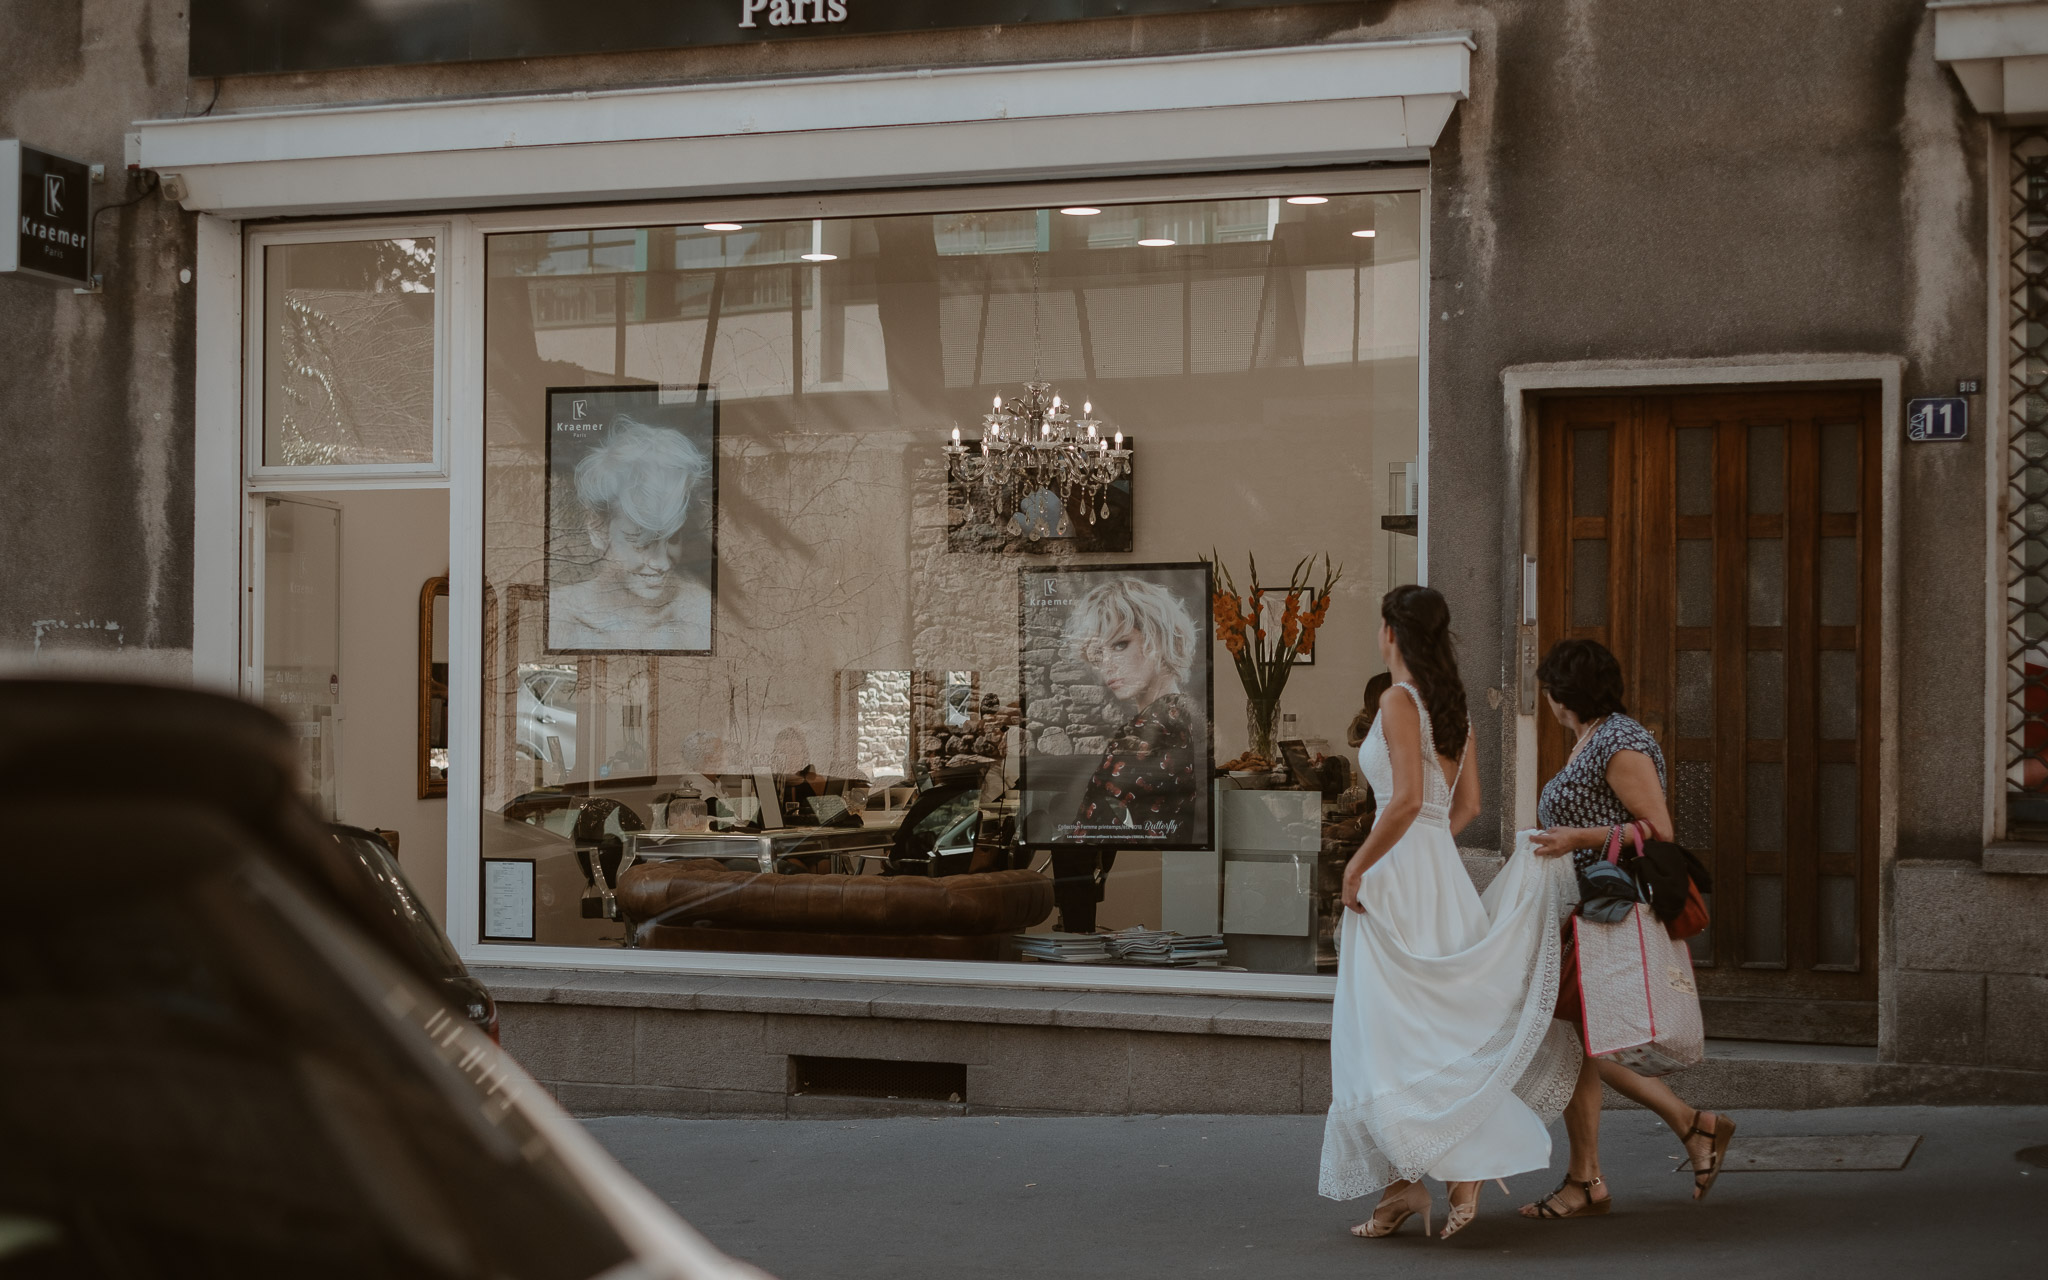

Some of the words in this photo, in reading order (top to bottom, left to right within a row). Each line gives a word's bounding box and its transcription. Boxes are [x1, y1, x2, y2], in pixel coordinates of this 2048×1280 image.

[738, 0, 848, 28] Paris
[21, 216, 86, 248] Kraemer
[44, 245, 64, 259] Paris
[1960, 382, 1976, 392] BIS
[1922, 404, 1951, 434] 11
[556, 422, 603, 432] Kraemer
[1029, 598, 1073, 606] Kraemer
[1143, 819, 1178, 834] Butterfly
